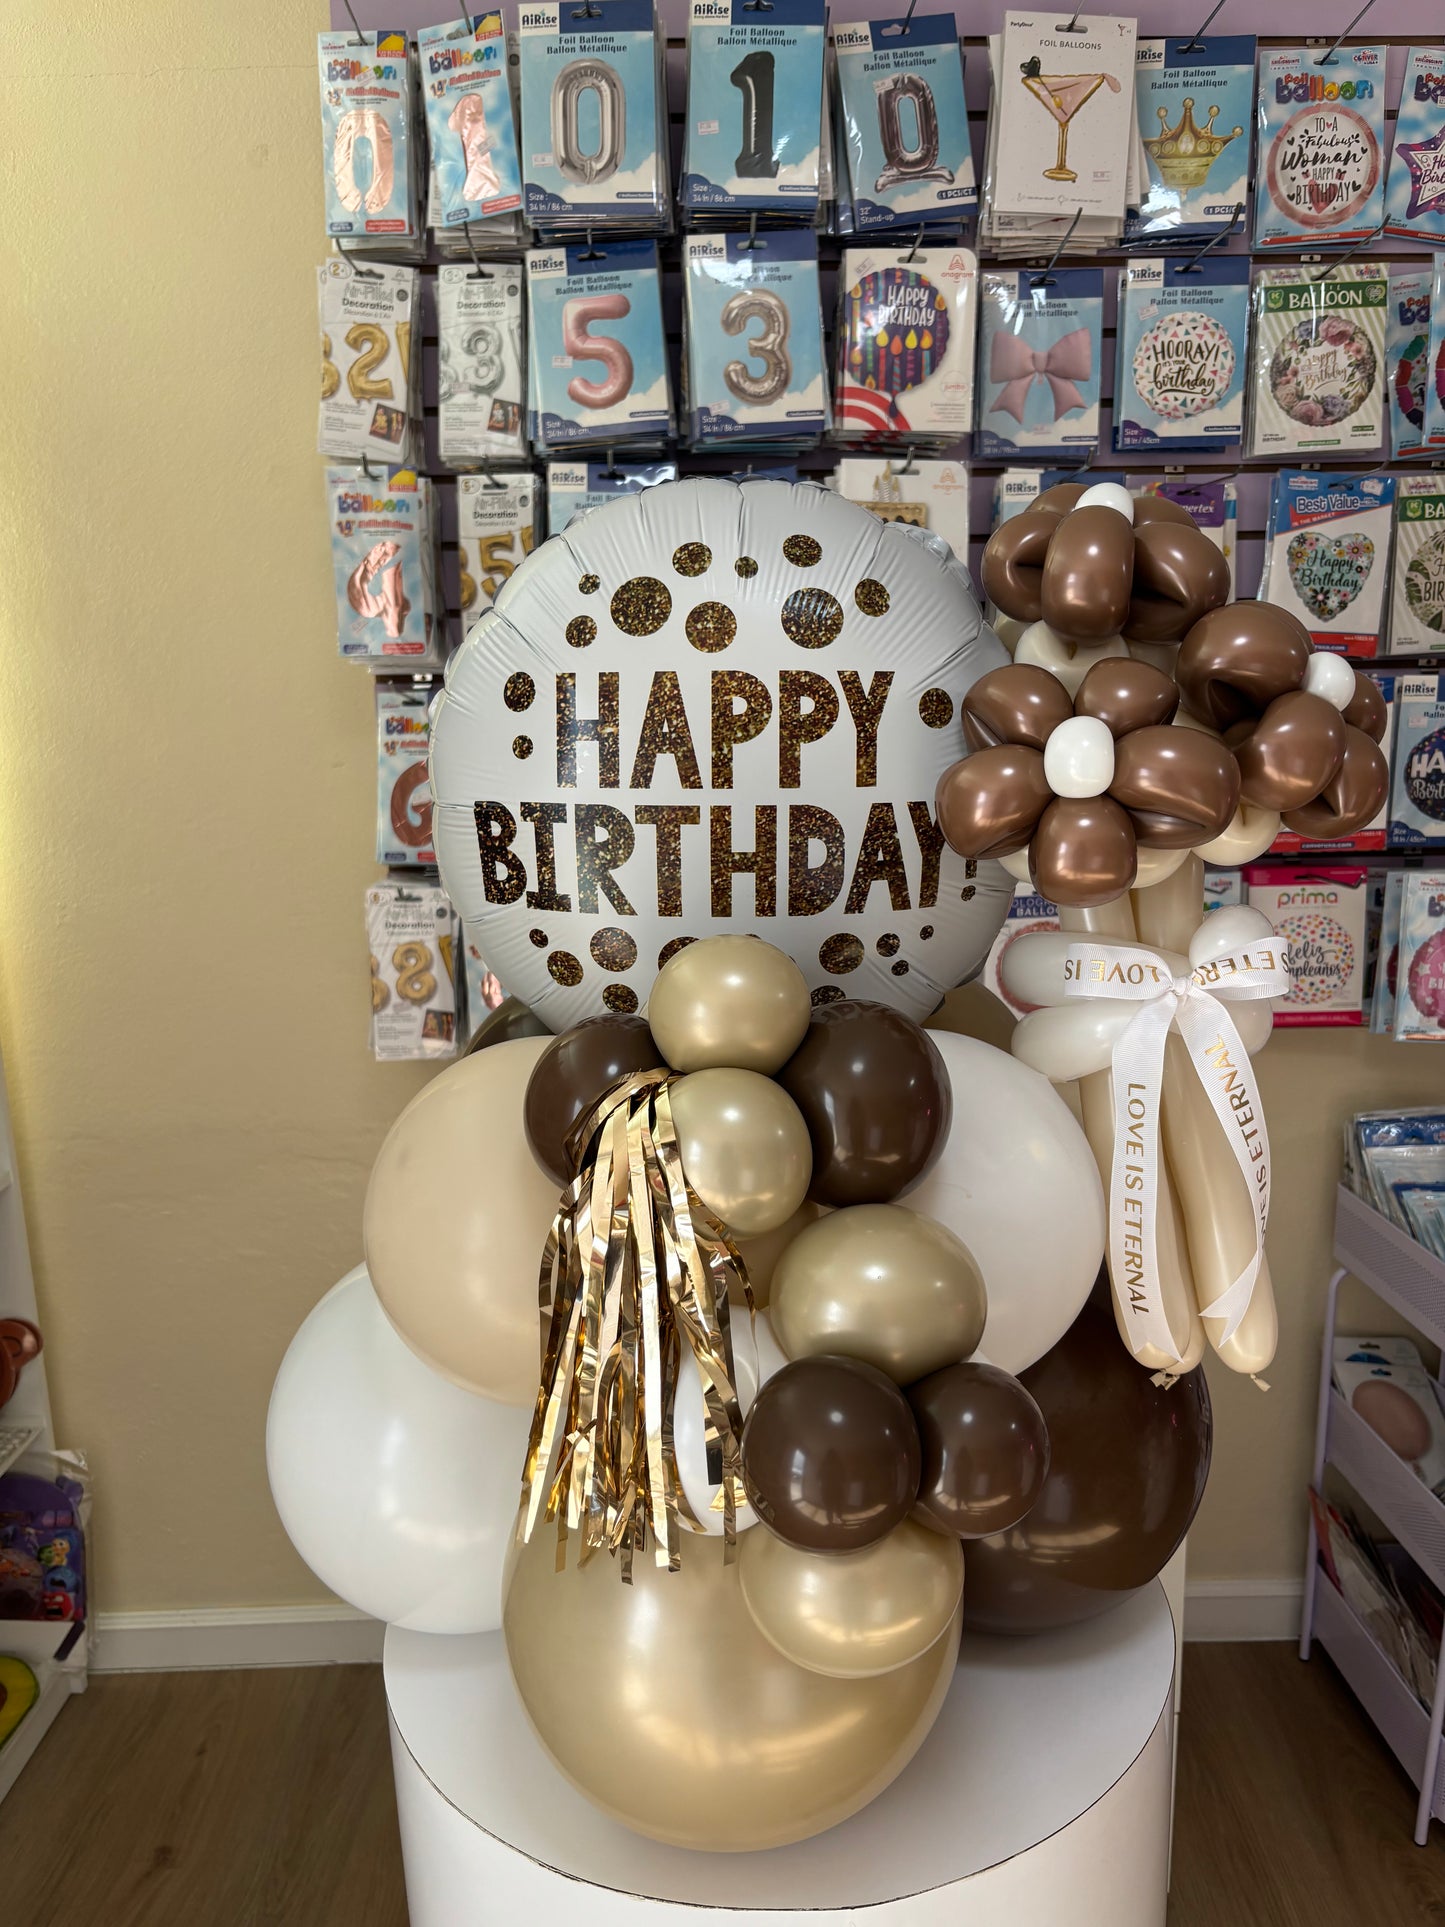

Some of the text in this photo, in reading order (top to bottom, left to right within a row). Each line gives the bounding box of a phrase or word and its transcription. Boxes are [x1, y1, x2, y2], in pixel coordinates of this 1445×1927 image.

[694, 2, 729, 16] AiRise
[522, 12, 557, 25] AiRise
[730, 28, 785, 37] Foil Balloon
[836, 33, 870, 45] AiRise
[559, 35, 615, 45] Foil Balloon
[717, 36, 797, 46] Ballon Métallique
[1039, 39, 1102, 50] FOIL BALLOONS
[547, 44, 628, 54] Ballon Métallique
[1137, 50, 1163, 60] iRise
[873, 50, 925, 62] Foil Balloon
[863, 57, 937, 72] Ballon Métallique
[1163, 69, 1217, 79] Foil Balloon
[1284, 72, 1308, 85] Foil
[1151, 77, 1228, 90] Ballon Métallique
[1276, 75, 1374, 104] balloon
[1315, 117, 1338, 132] TO A
[1281, 149, 1362, 171] Woman
[1312, 168, 1335, 181] HAPPY
[528, 193, 544, 201] Size
[1296, 182, 1351, 205] BIRTHDAY
[1214, 206, 1237, 214] PCS/C
[860, 213, 895, 225] Stand-up
[689, 243, 724, 256] AiRise
[531, 257, 564, 270] AiRise
[567, 274, 620, 286] Foil Balloon
[556, 286, 584, 296] Ballon
[887, 285, 929, 307] HAPPY
[1181, 289, 1213, 297] Balloon
[342, 298, 394, 312] Decoration
[1181, 297, 1224, 305] Métallique
[1289, 290, 1362, 309] BALLOON
[878, 305, 936, 327] BIRTHDAY
[1152, 340, 1220, 367] HOORAY!
[1149, 363, 1215, 396] birthday
[1005, 483, 1037, 494] AiRise
[1297, 497, 1327, 514] Best
[1328, 495, 1360, 511] Value
[1307, 549, 1354, 574] Happy
[1300, 569, 1362, 592] Birthday
[1404, 683, 1436, 695] AiRise
[555, 670, 895, 790] HAPPY
[1277, 888, 1338, 909] prima
[1017, 906, 1058, 917] BALLO
[1065, 959, 1160, 986] LOVE IS
[1288, 961, 1341, 979] mpleaños
[1205, 1034, 1262, 1163] ETERNAL
[1124, 1082, 1150, 1316] LOVE IS ETERNAL
